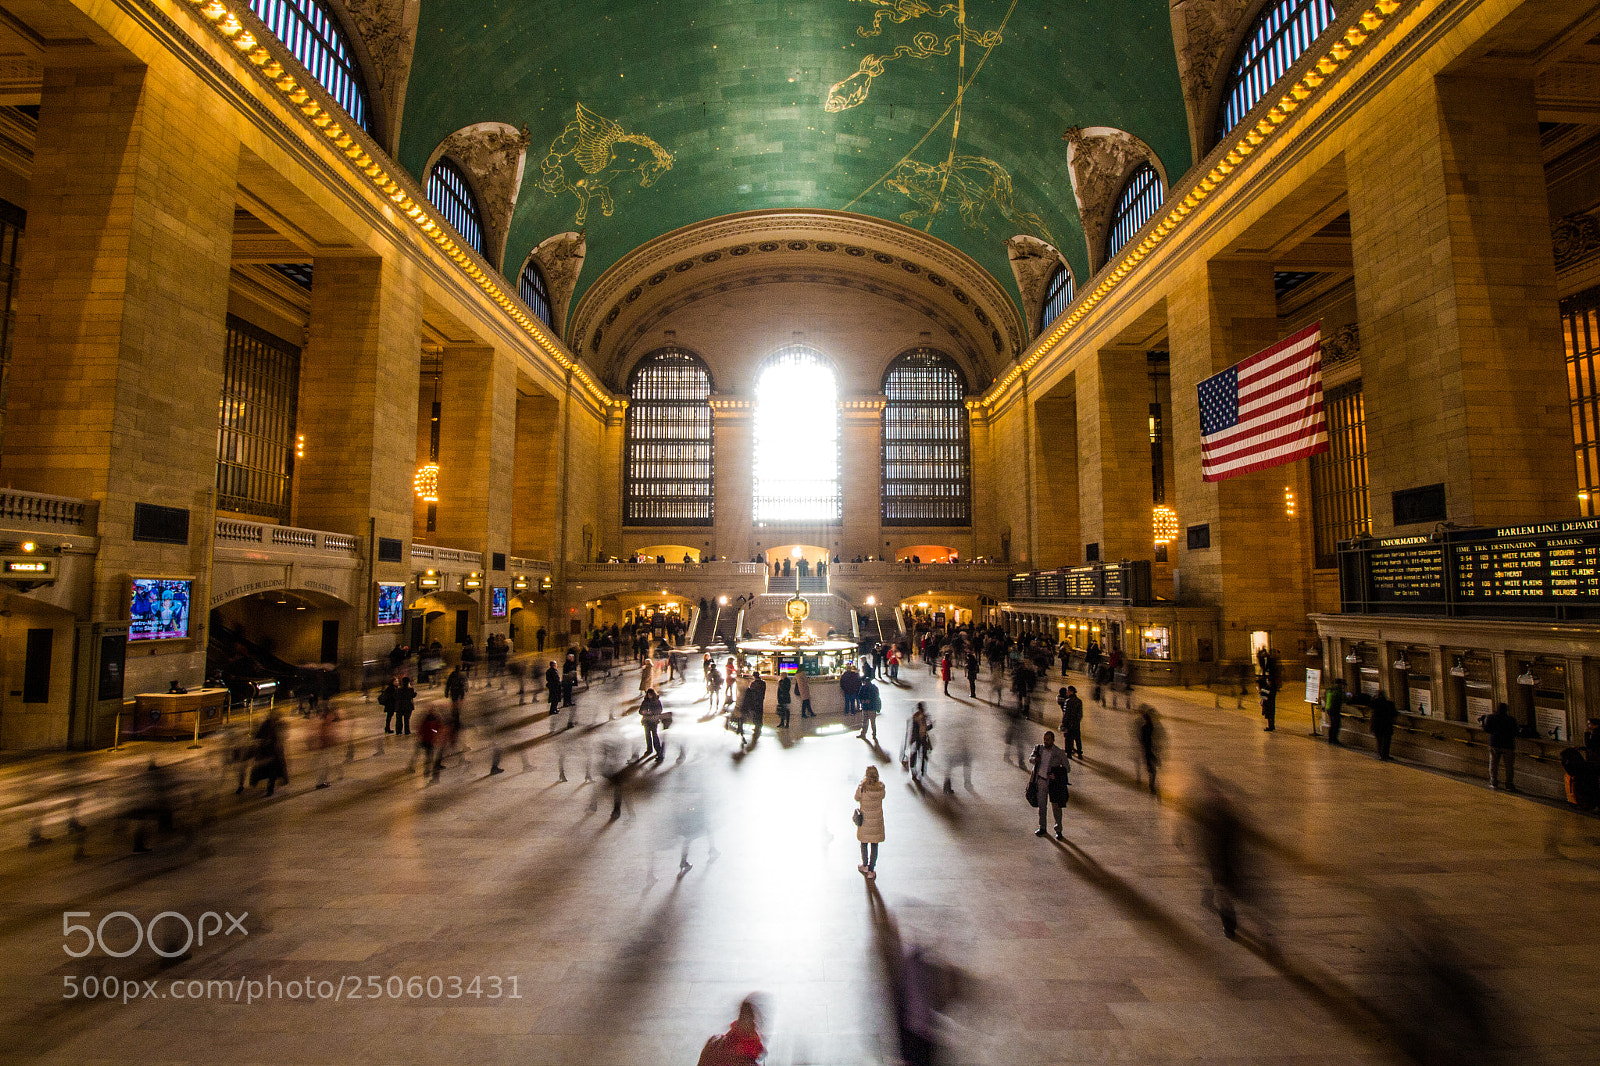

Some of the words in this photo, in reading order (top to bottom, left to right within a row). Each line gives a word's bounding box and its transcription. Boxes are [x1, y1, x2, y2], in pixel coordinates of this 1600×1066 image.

[1497, 526, 1535, 536] HARLEM
[1537, 524, 1560, 533] LINE
[1380, 536, 1428, 546] INFORMATION
[1490, 542, 1536, 550] DESTINATION
[1546, 538, 1584, 546] REMARKS
[225, 583, 254, 598] METLIFE
[255, 579, 286, 589] BUILDING
[318, 582, 338, 594] STREET
